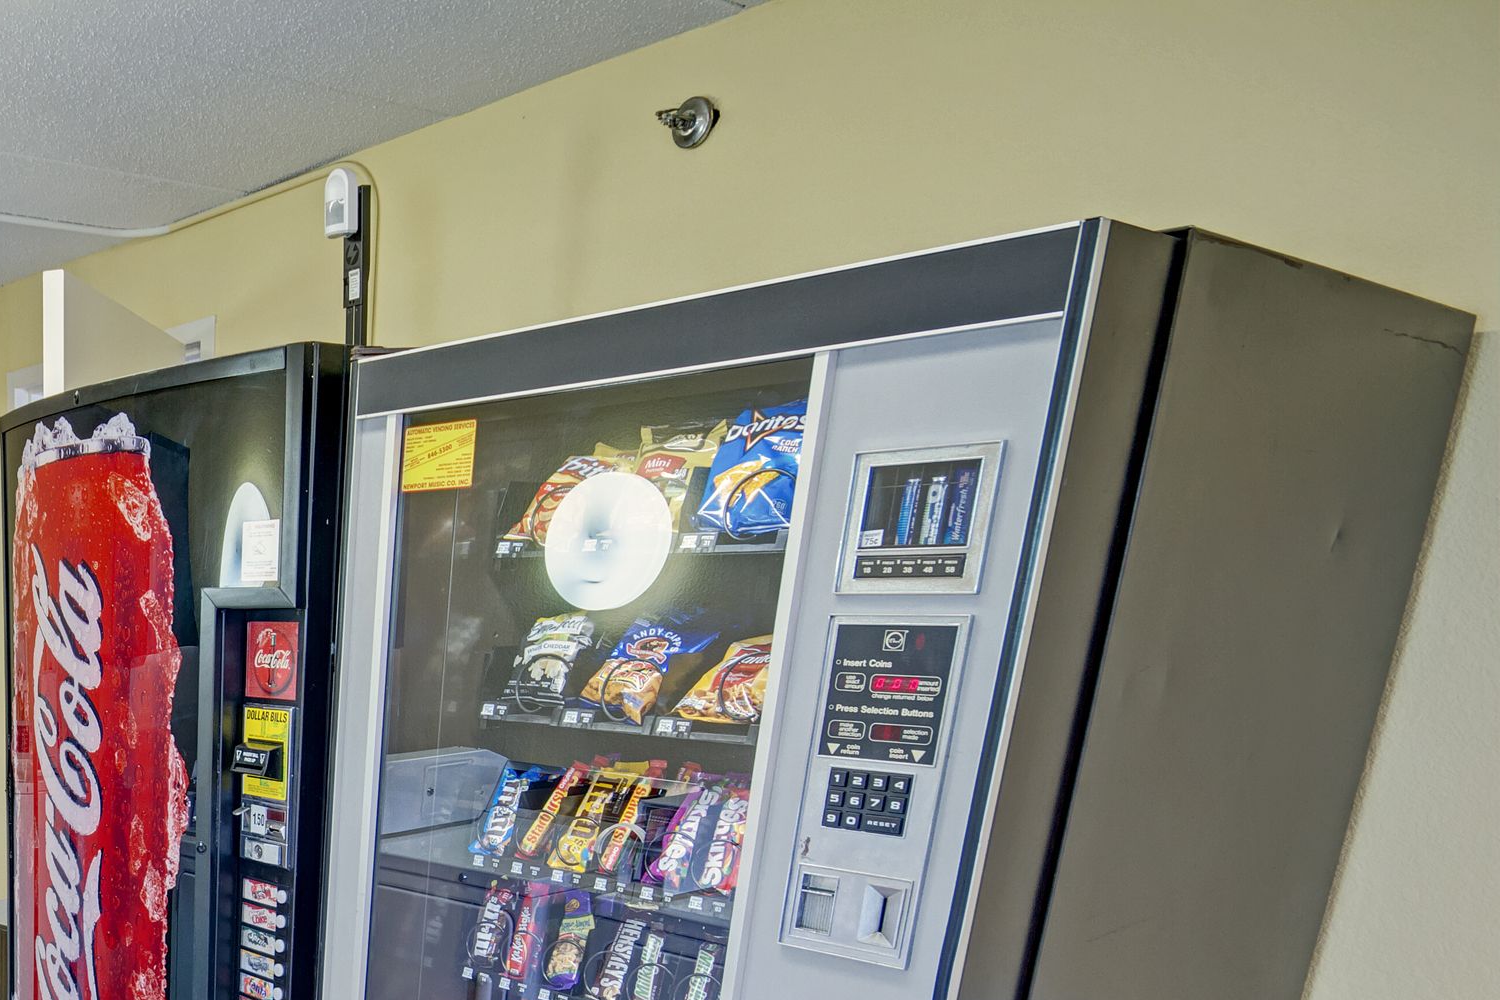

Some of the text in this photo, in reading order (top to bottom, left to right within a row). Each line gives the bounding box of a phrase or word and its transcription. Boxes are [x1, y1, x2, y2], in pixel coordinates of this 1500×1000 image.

[724, 414, 807, 442] Doritos
[645, 458, 672, 469] Mini
[951, 486, 969, 541] Winterfresh
[633, 628, 664, 640] ANDY
[254, 648, 291, 670] Coca-Cola
[843, 658, 892, 668] Insert Coins
[836, 704, 934, 718] Press Selection Buttons
[246, 709, 288, 723] DOLLAR BILLS
[852, 776, 863, 785] 2
[873, 778, 883, 787] 3
[894, 781, 904, 790] 4
[830, 794, 839, 803] 5
[850, 797, 860, 805] 6
[870, 799, 880, 807] 7
[890, 801, 900, 810] 8
[826, 814, 836, 822] 9
[846, 816, 856, 825] 0
